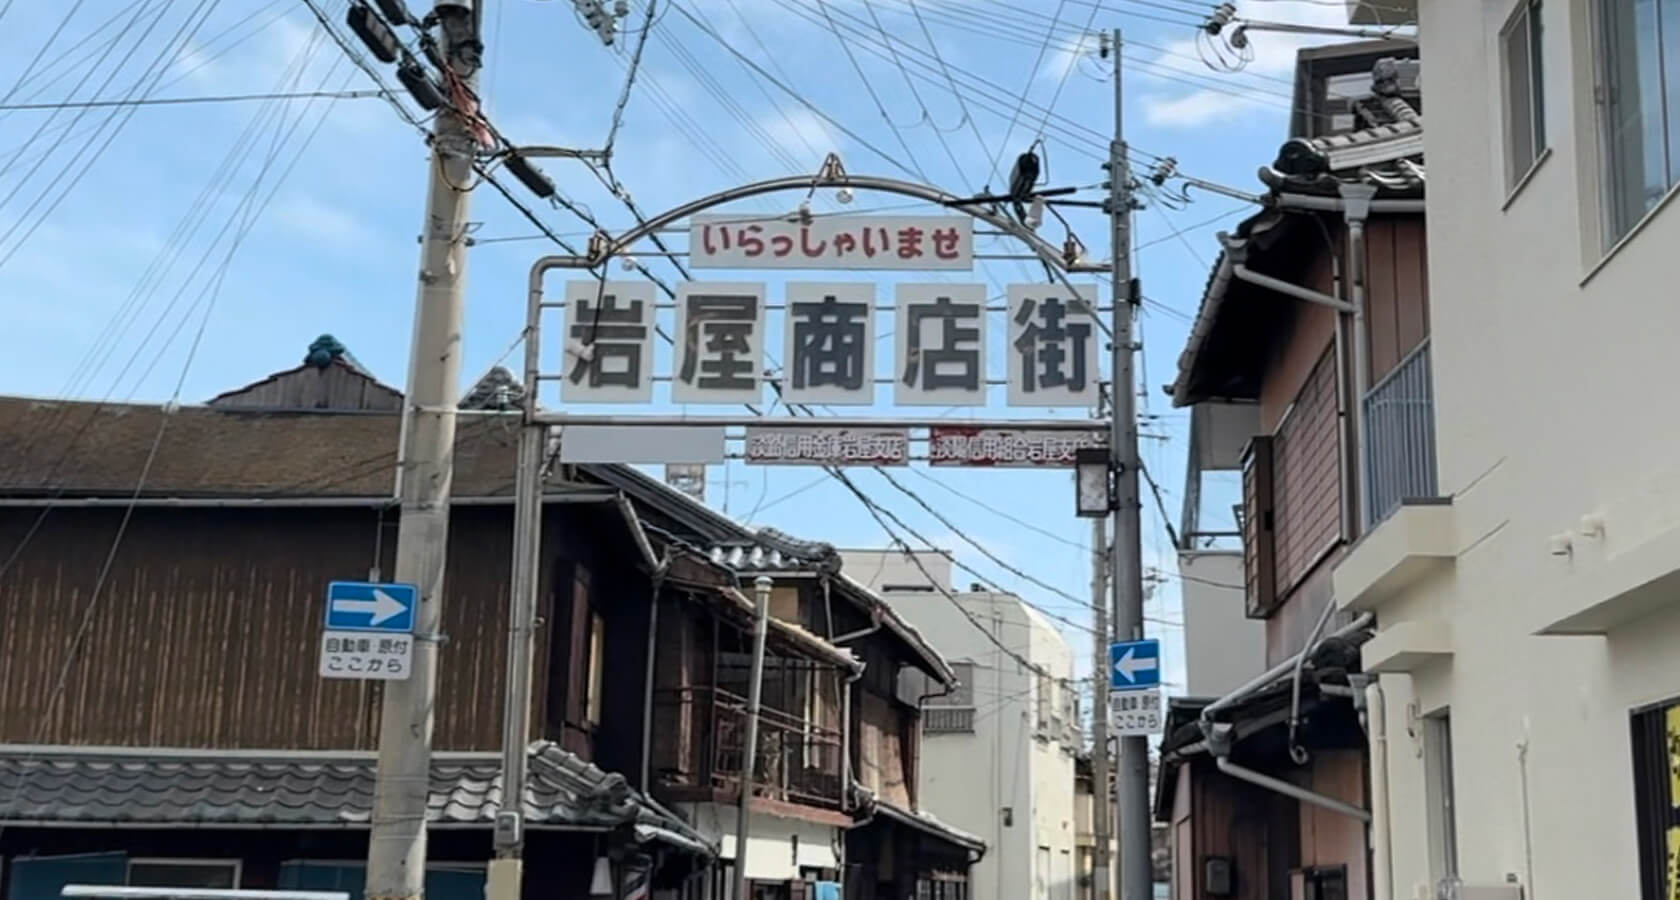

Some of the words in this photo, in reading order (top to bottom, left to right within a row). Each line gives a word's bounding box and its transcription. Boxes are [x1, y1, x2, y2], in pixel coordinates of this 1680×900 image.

[702, 225, 960, 260] いらっしゃいませ
[569, 295, 1092, 393] 岩屋商店街
[328, 655, 402, 673] ここから
[1114, 713, 1158, 730] ここから
